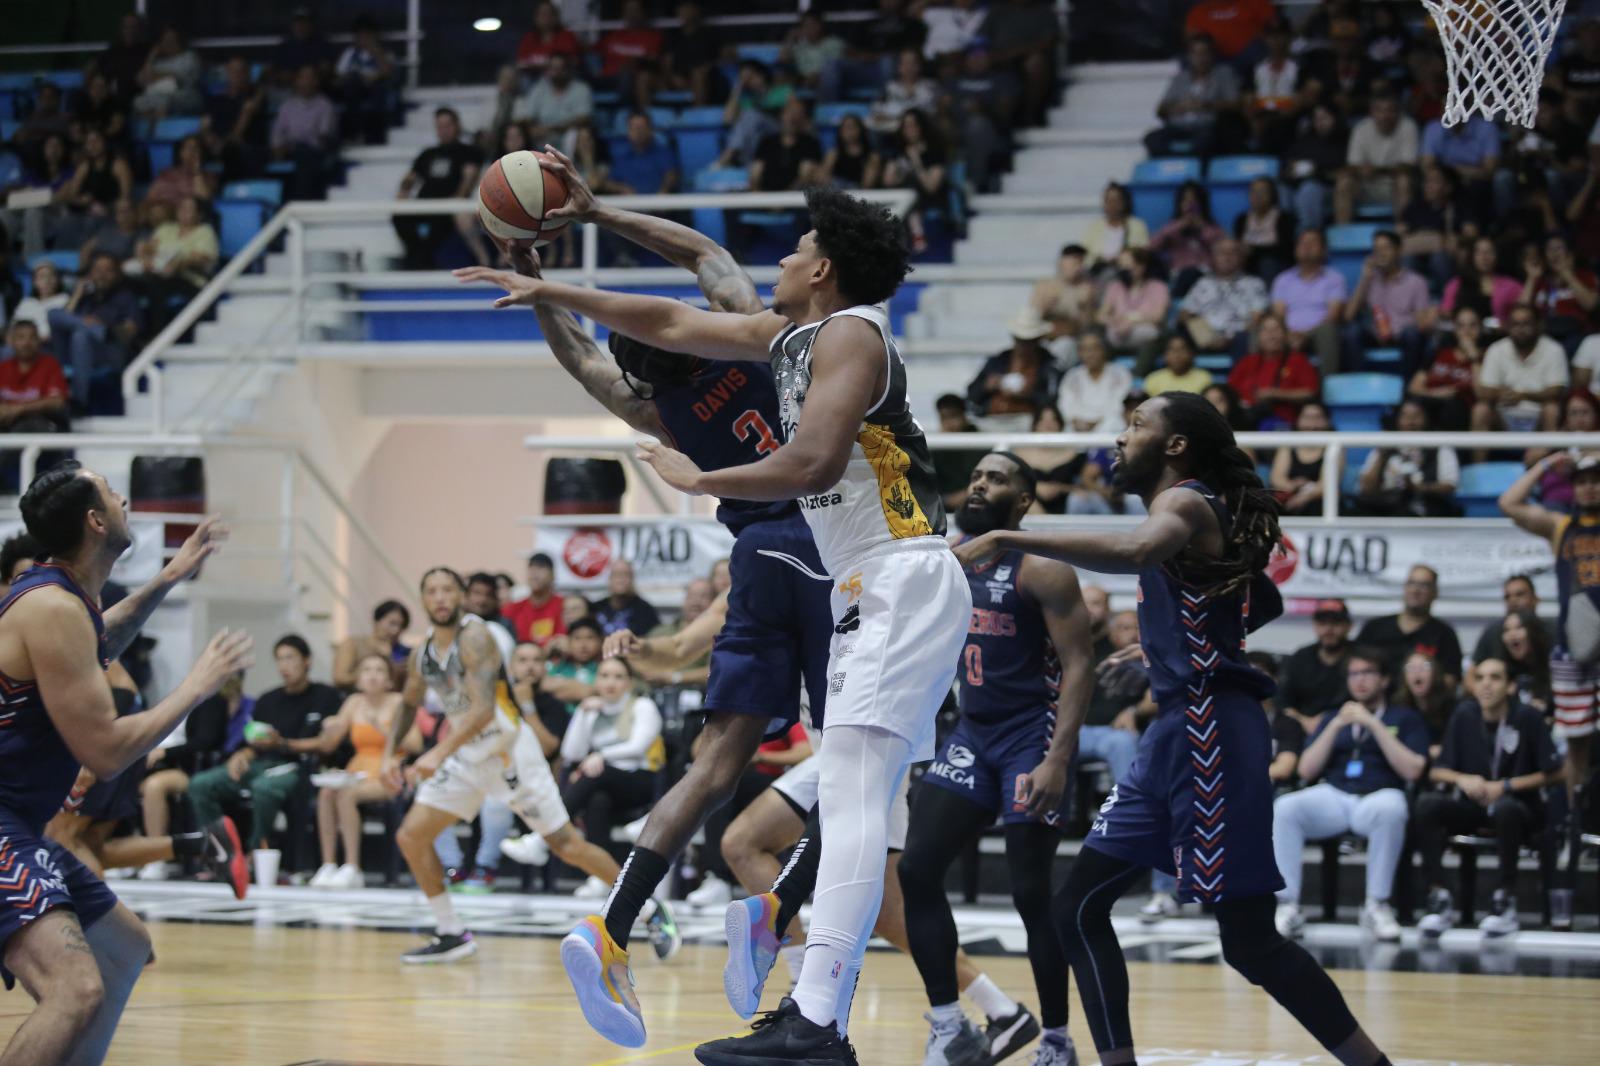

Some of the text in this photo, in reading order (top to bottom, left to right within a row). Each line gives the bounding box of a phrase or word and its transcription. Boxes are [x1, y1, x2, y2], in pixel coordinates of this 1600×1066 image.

[691, 368, 748, 421] DAVIS
[732, 409, 780, 455] 3
[619, 526, 692, 564] UAD
[1306, 534, 1389, 573] UAD
[964, 644, 984, 686] 0
[928, 761, 975, 790] MEGA
